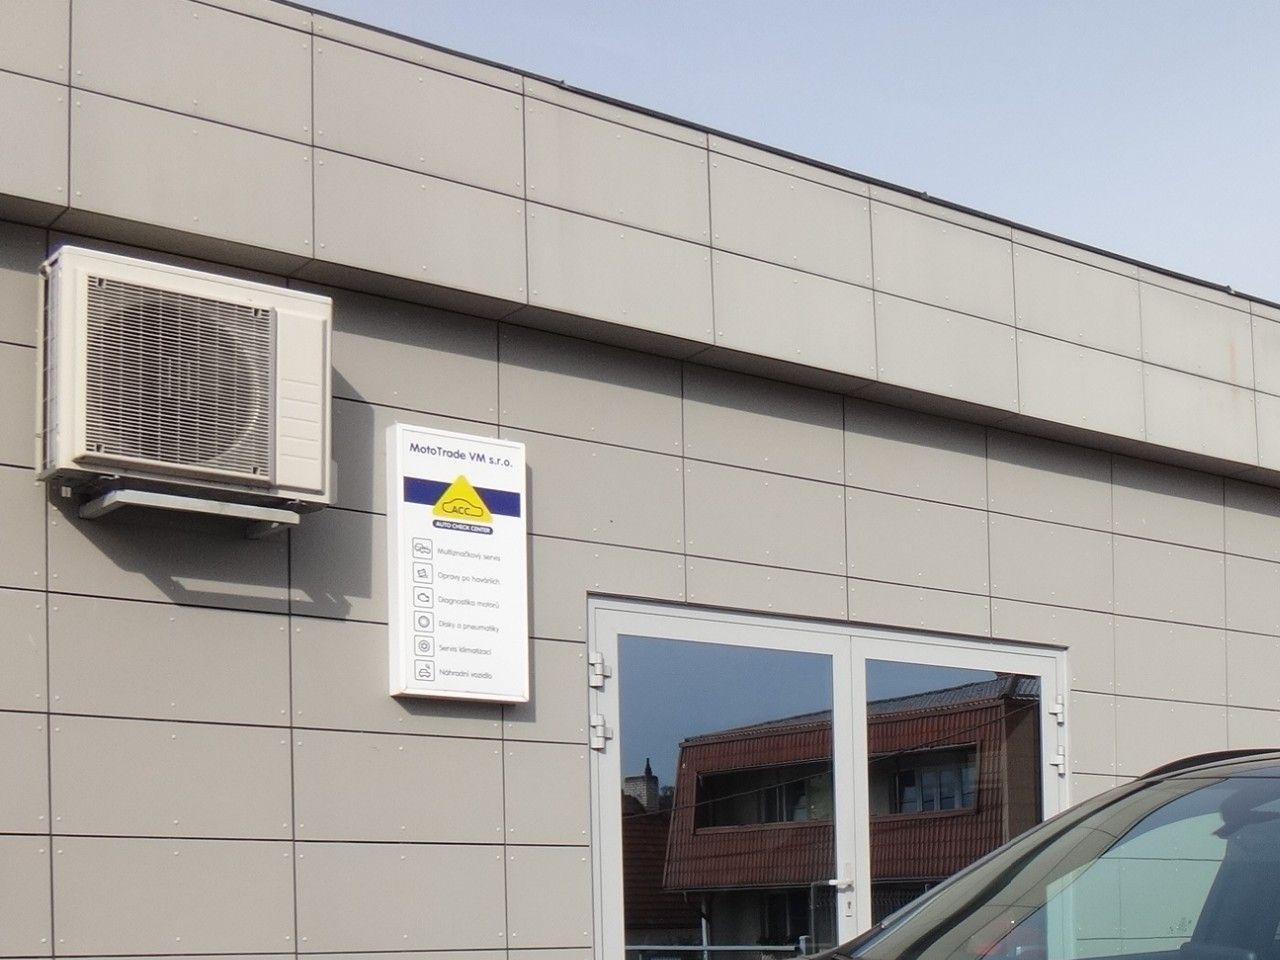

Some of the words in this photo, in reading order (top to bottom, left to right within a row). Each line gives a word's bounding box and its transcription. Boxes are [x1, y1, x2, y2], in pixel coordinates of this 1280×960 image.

[409, 442, 466, 460] MotoTrade
[469, 451, 486, 463] VM
[488, 456, 513, 468] s.r.o.
